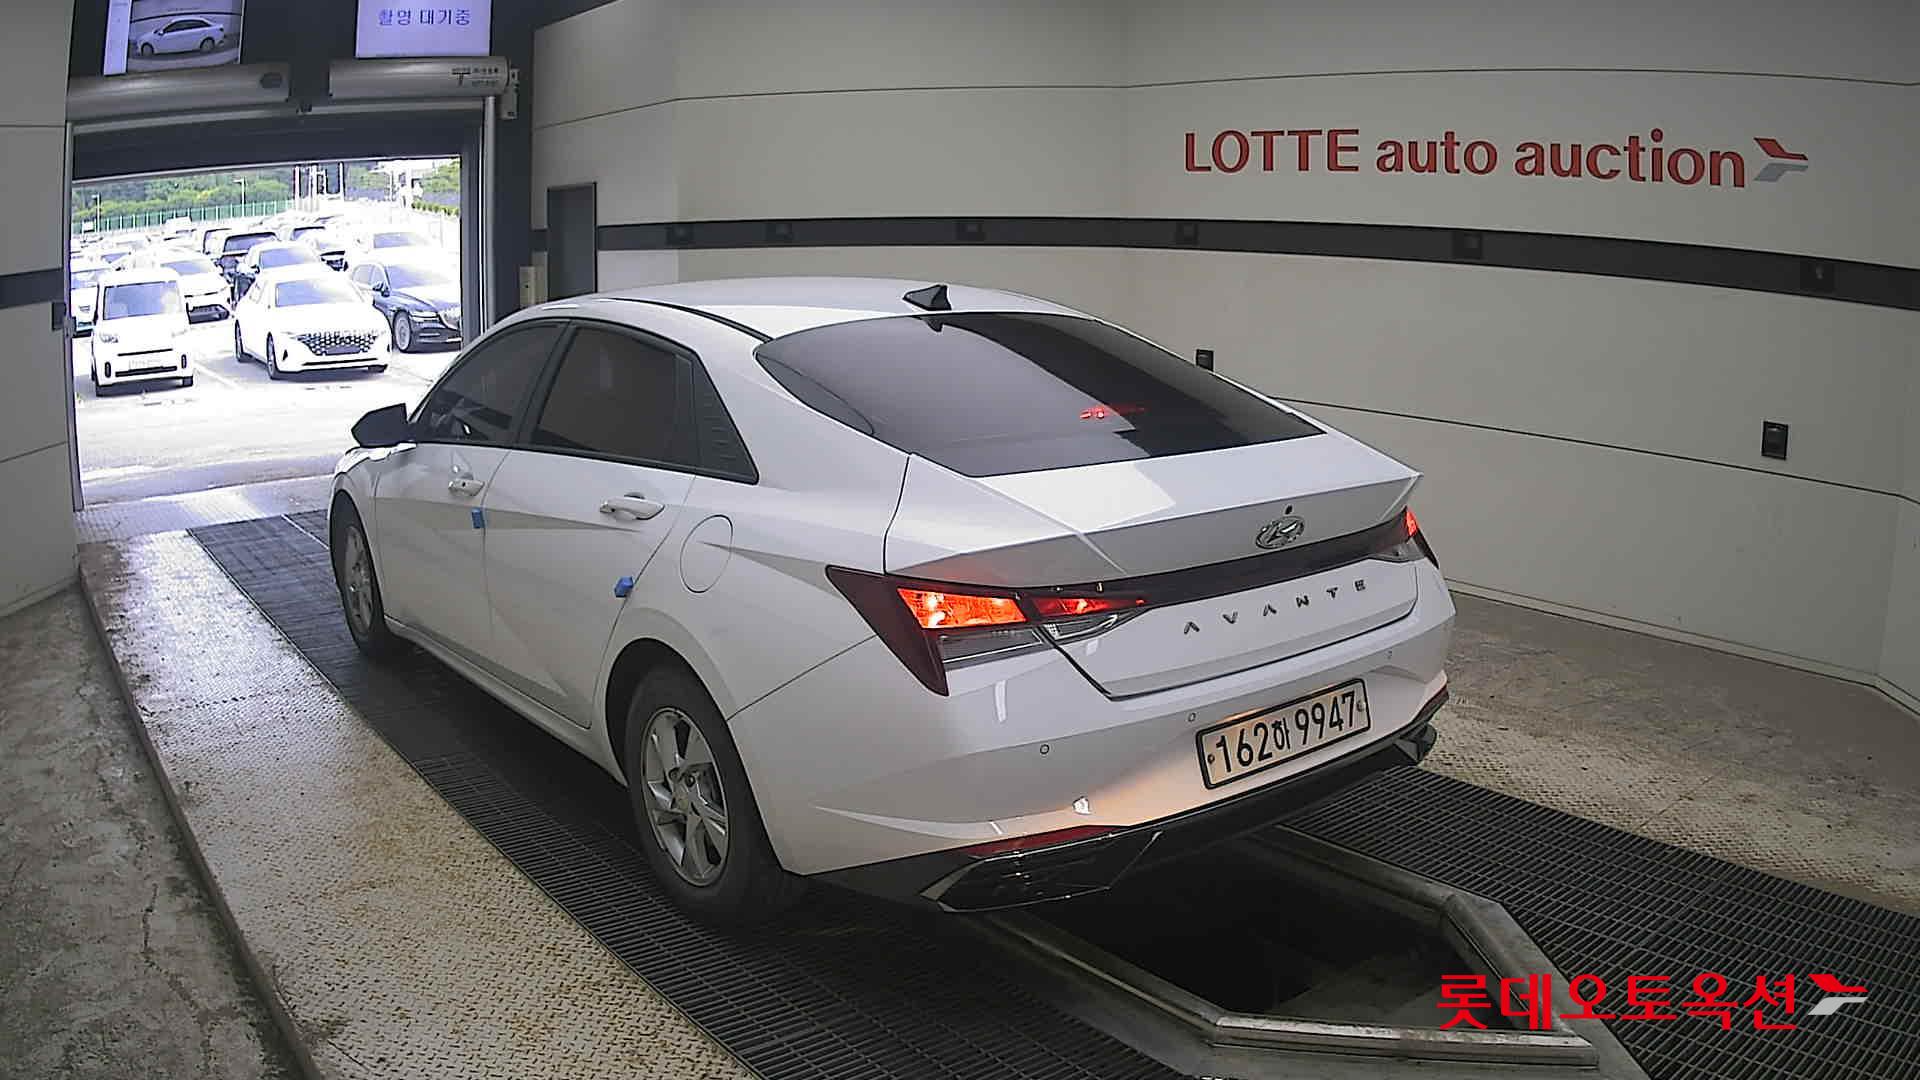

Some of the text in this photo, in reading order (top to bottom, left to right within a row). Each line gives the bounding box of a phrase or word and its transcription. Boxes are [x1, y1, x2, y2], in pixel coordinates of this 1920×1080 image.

[420, 9, 471, 26] 대기중
[1185, 128, 1745, 188] LOTTE auto auction
[1183, 579, 1366, 634] AVANTE
